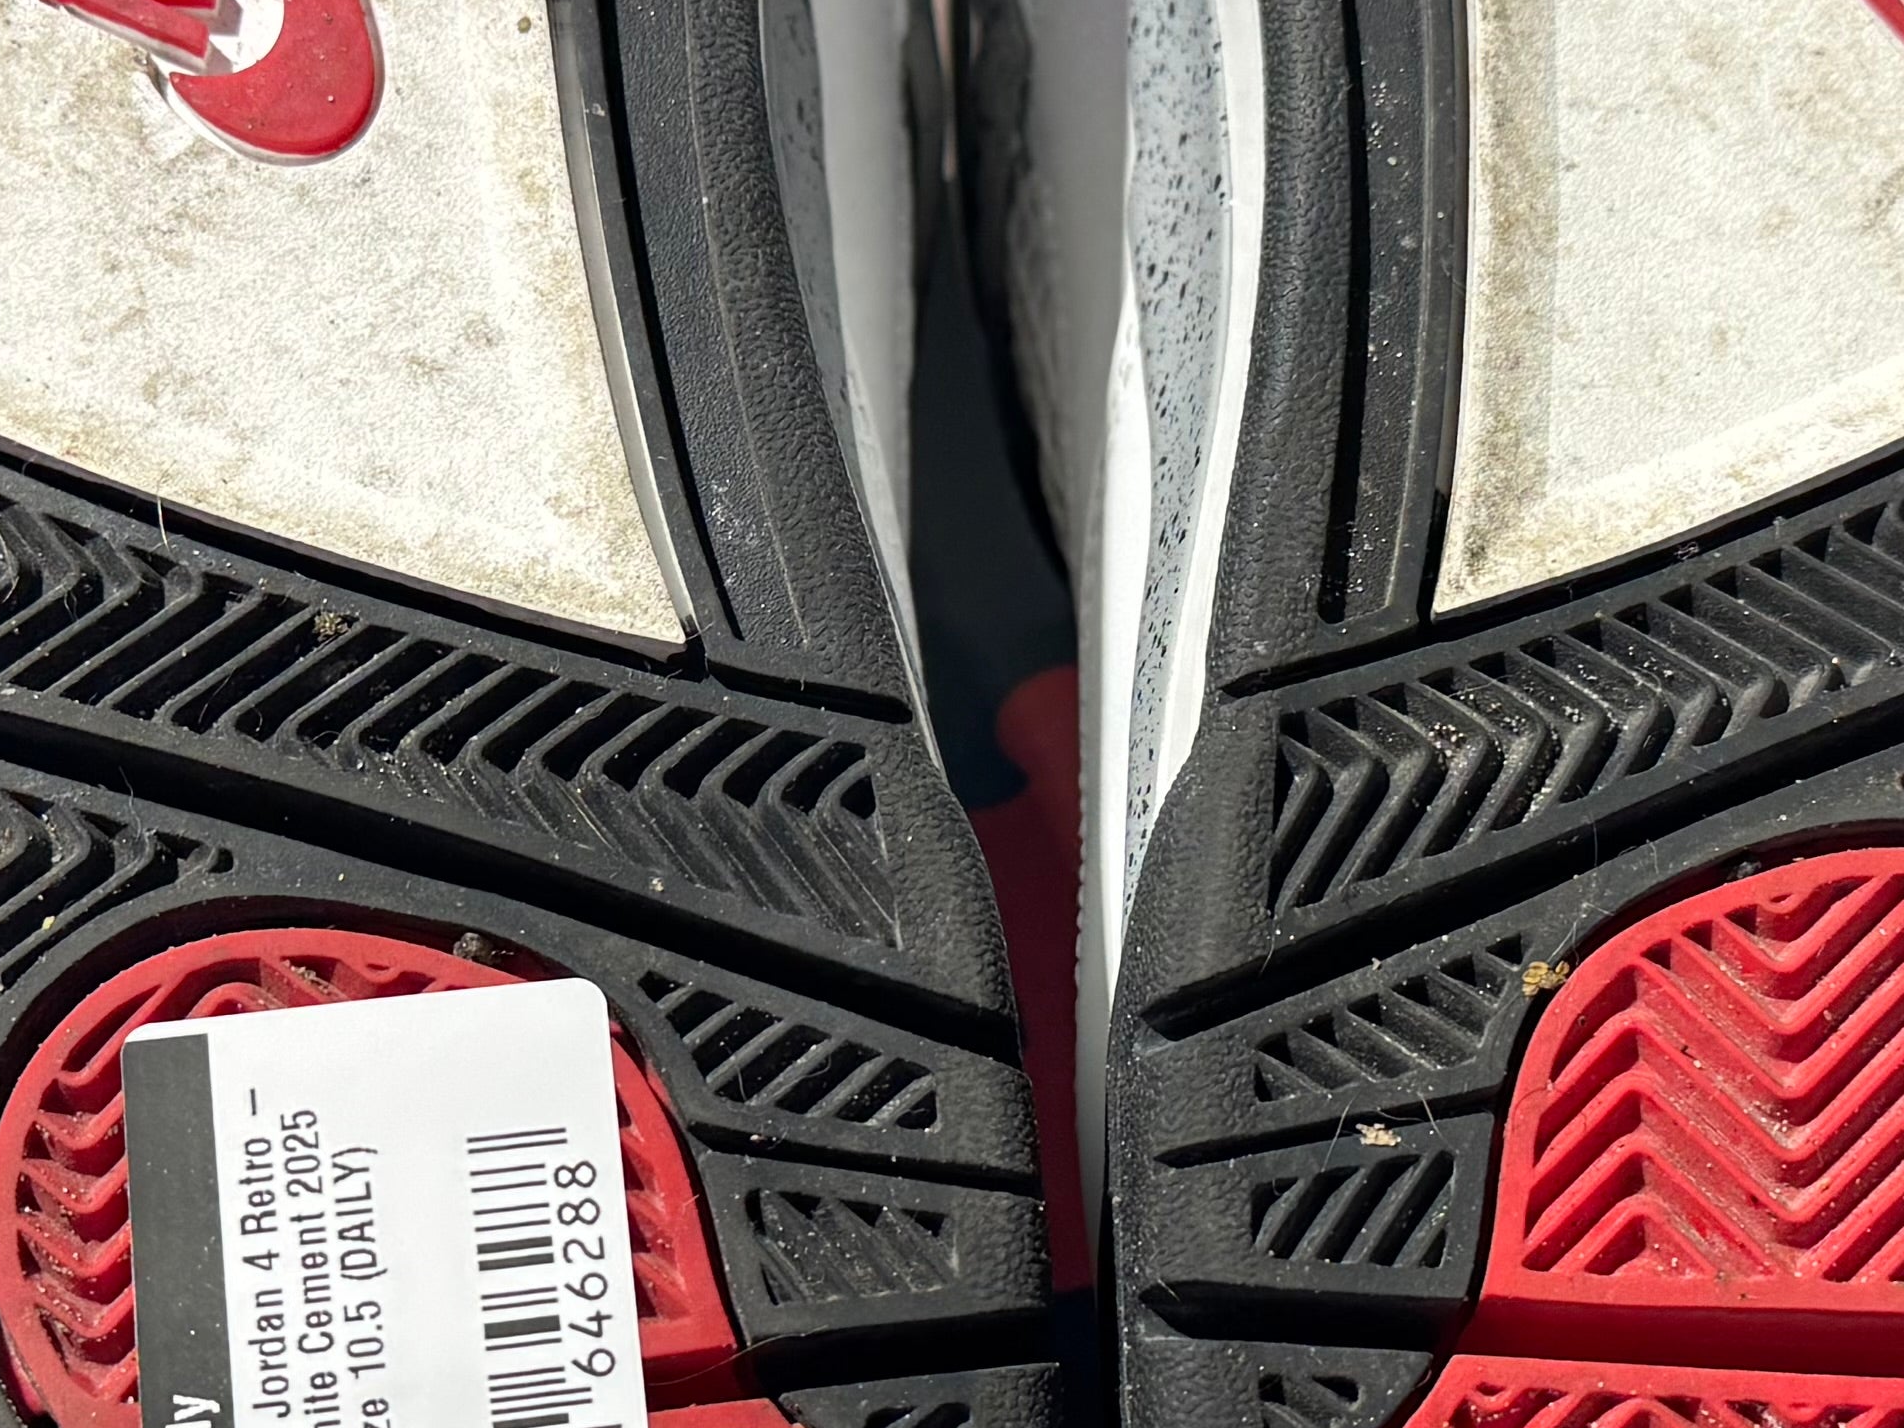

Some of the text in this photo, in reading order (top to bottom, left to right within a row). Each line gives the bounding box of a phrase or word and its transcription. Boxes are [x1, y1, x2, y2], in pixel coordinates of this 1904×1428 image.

[238, 1137, 278, 1237] Retro
[280, 1109, 325, 1198] 2025
[242, 1249, 280, 1271] 4
[330, 1146, 388, 1280] (DAILY)
[289, 1210, 335, 1355] Cement
[247, 1287, 291, 1419] Jordan
[342, 1299, 386, 1379] 10.5
